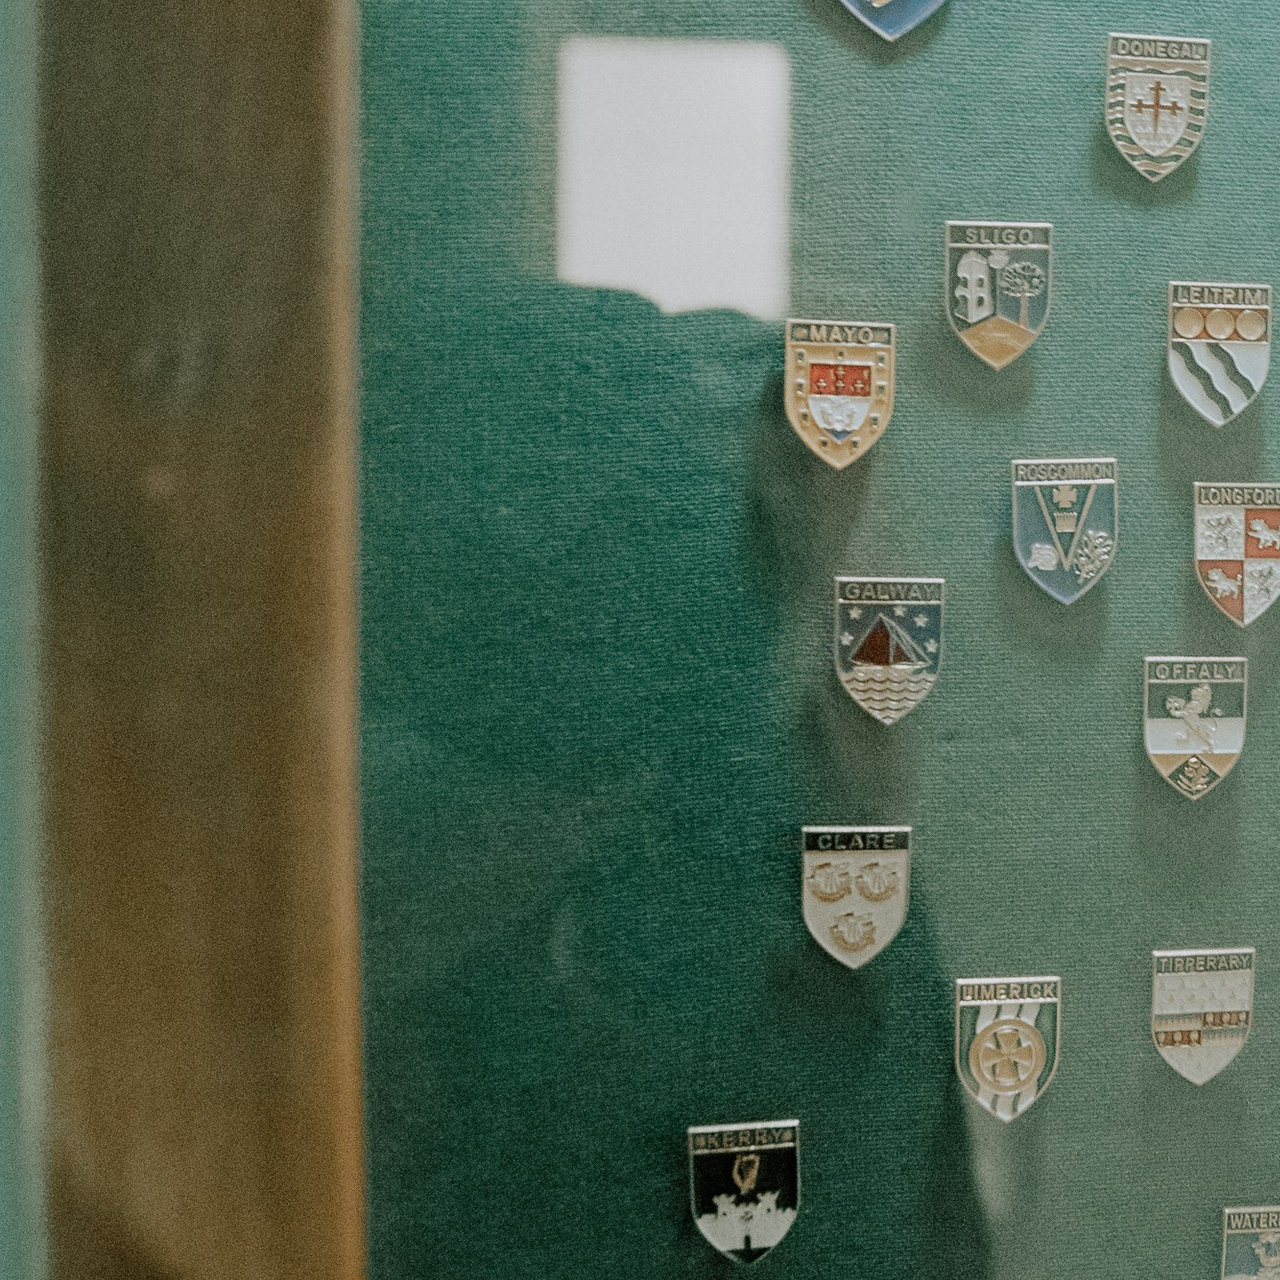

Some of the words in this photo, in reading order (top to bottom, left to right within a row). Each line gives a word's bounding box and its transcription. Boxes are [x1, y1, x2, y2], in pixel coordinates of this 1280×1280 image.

[1117, 39, 1202, 59] DONEGAL
[965, 227, 1034, 245] SLIGO
[1176, 286, 1263, 305] LEITRIM
[809, 325, 875, 344] MAYO
[1016, 463, 1113, 482] ROSCOMMON
[845, 583, 936, 600] GALWAY
[1155, 663, 1238, 681] OFFALY
[817, 833, 896, 851] CLARE
[1159, 954, 1251, 973] TIPPERARY
[961, 982, 1057, 1002] LIMERICK
[707, 1128, 784, 1151] KERRY
